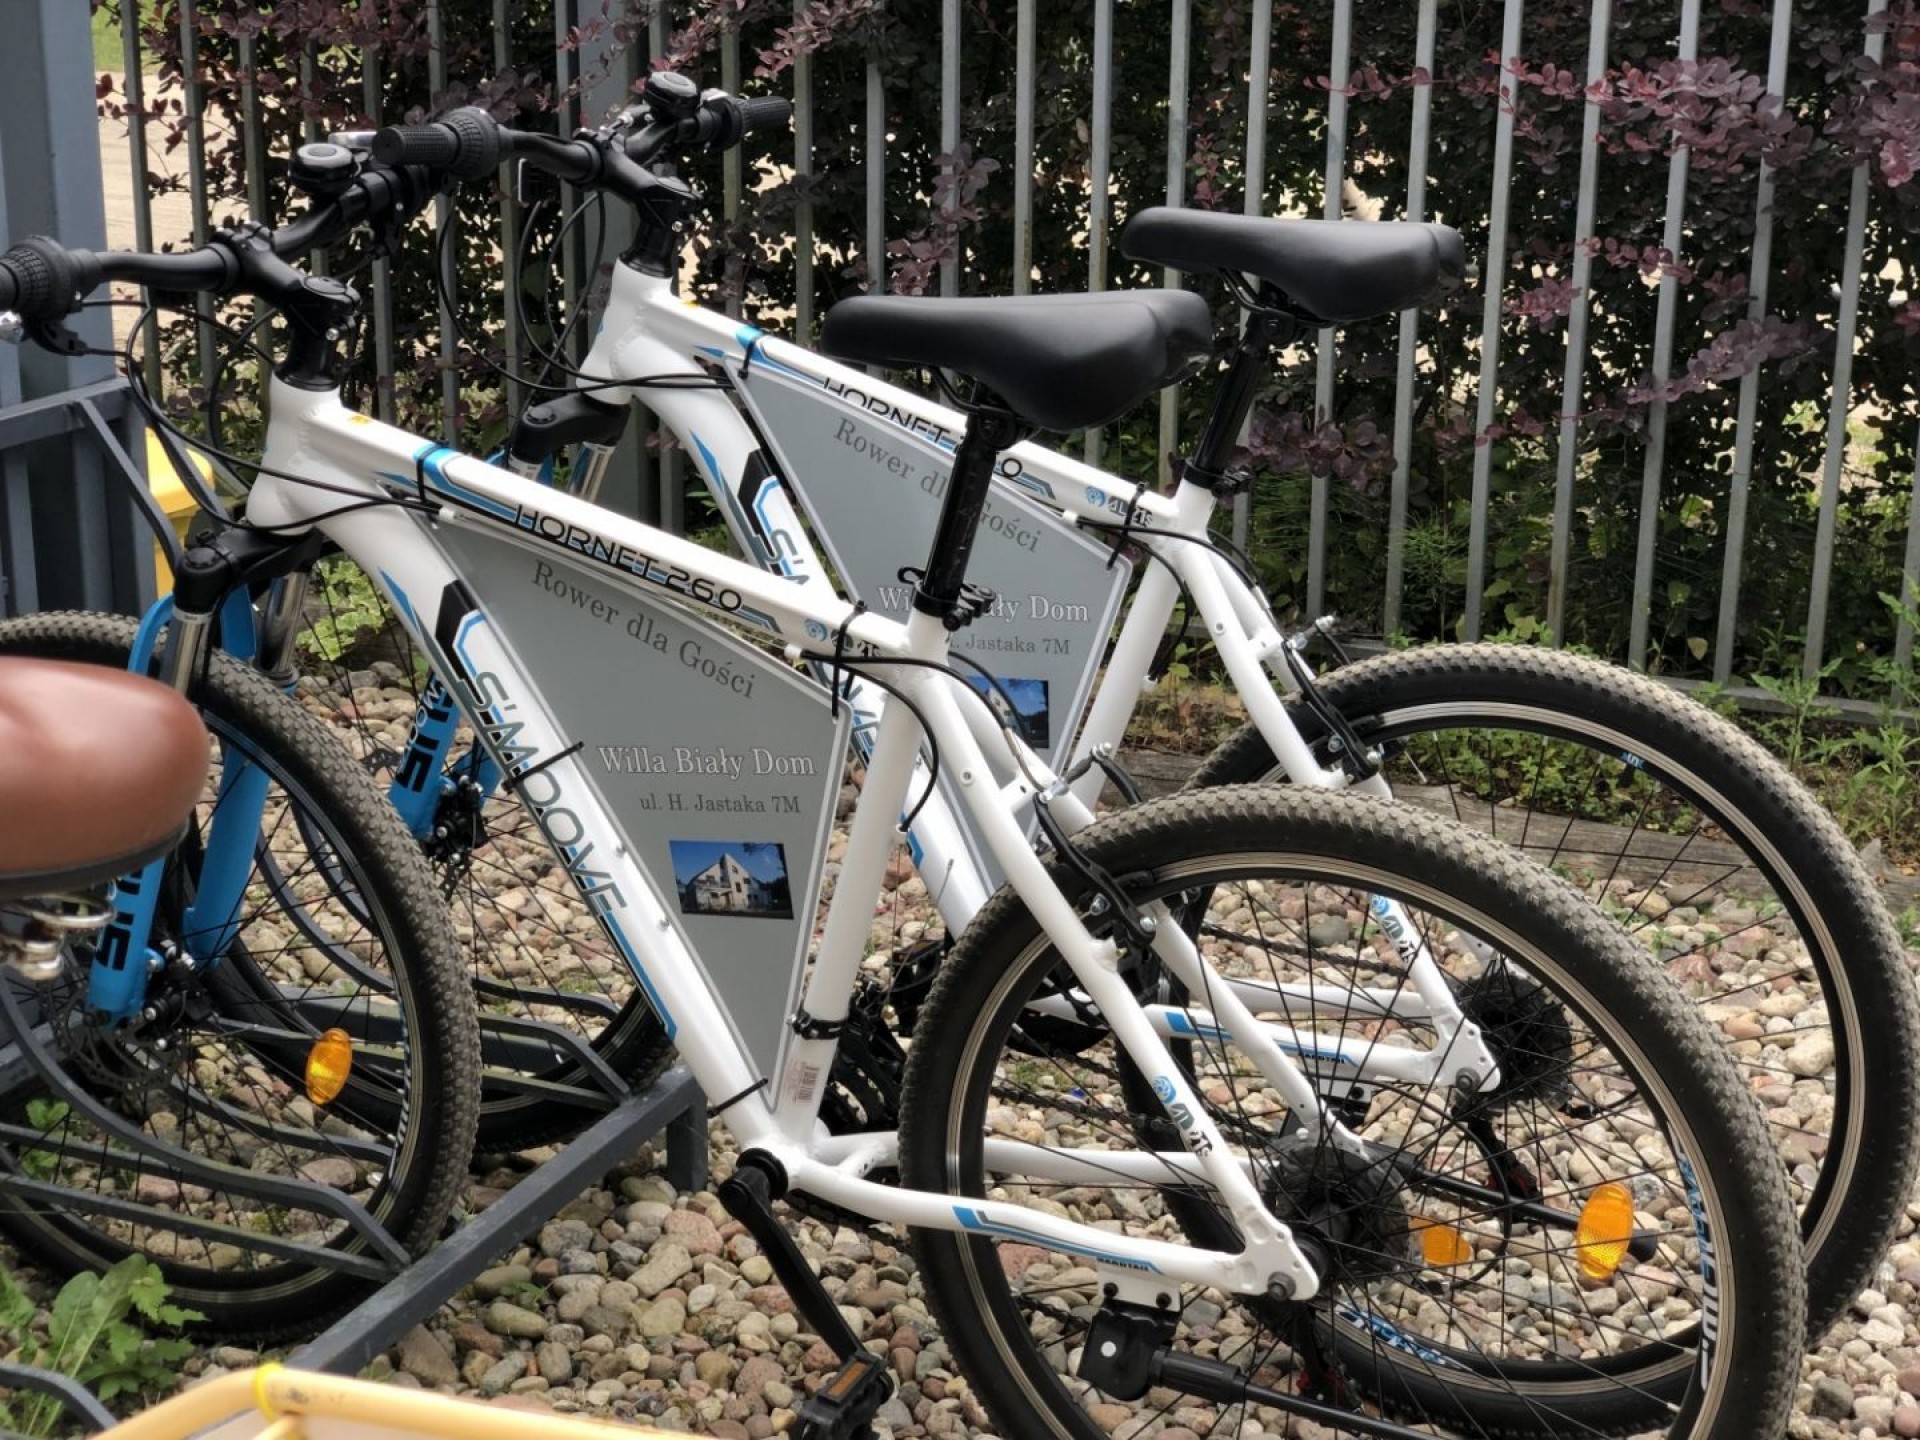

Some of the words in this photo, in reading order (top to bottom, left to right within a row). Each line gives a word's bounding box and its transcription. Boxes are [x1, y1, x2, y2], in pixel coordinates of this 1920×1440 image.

[833, 417, 915, 480] Rower
[920, 471, 948, 499] dl
[665, 565, 743, 613] 260
[1028, 595, 1089, 621] Dom
[532, 560, 620, 626] Rower
[626, 614, 668, 654] dla
[679, 639, 756, 698] Gości
[964, 633, 1036, 653] Jastaka
[1043, 638, 1070, 655] 7M
[597, 746, 668, 773] Willa
[673, 747, 744, 780] Biały
[752, 748, 816, 776] Dom
[640, 793, 663, 811] ul.
[668, 794, 688, 812] H.
[694, 794, 767, 813] Jastaka
[772, 795, 800, 813] 7M
